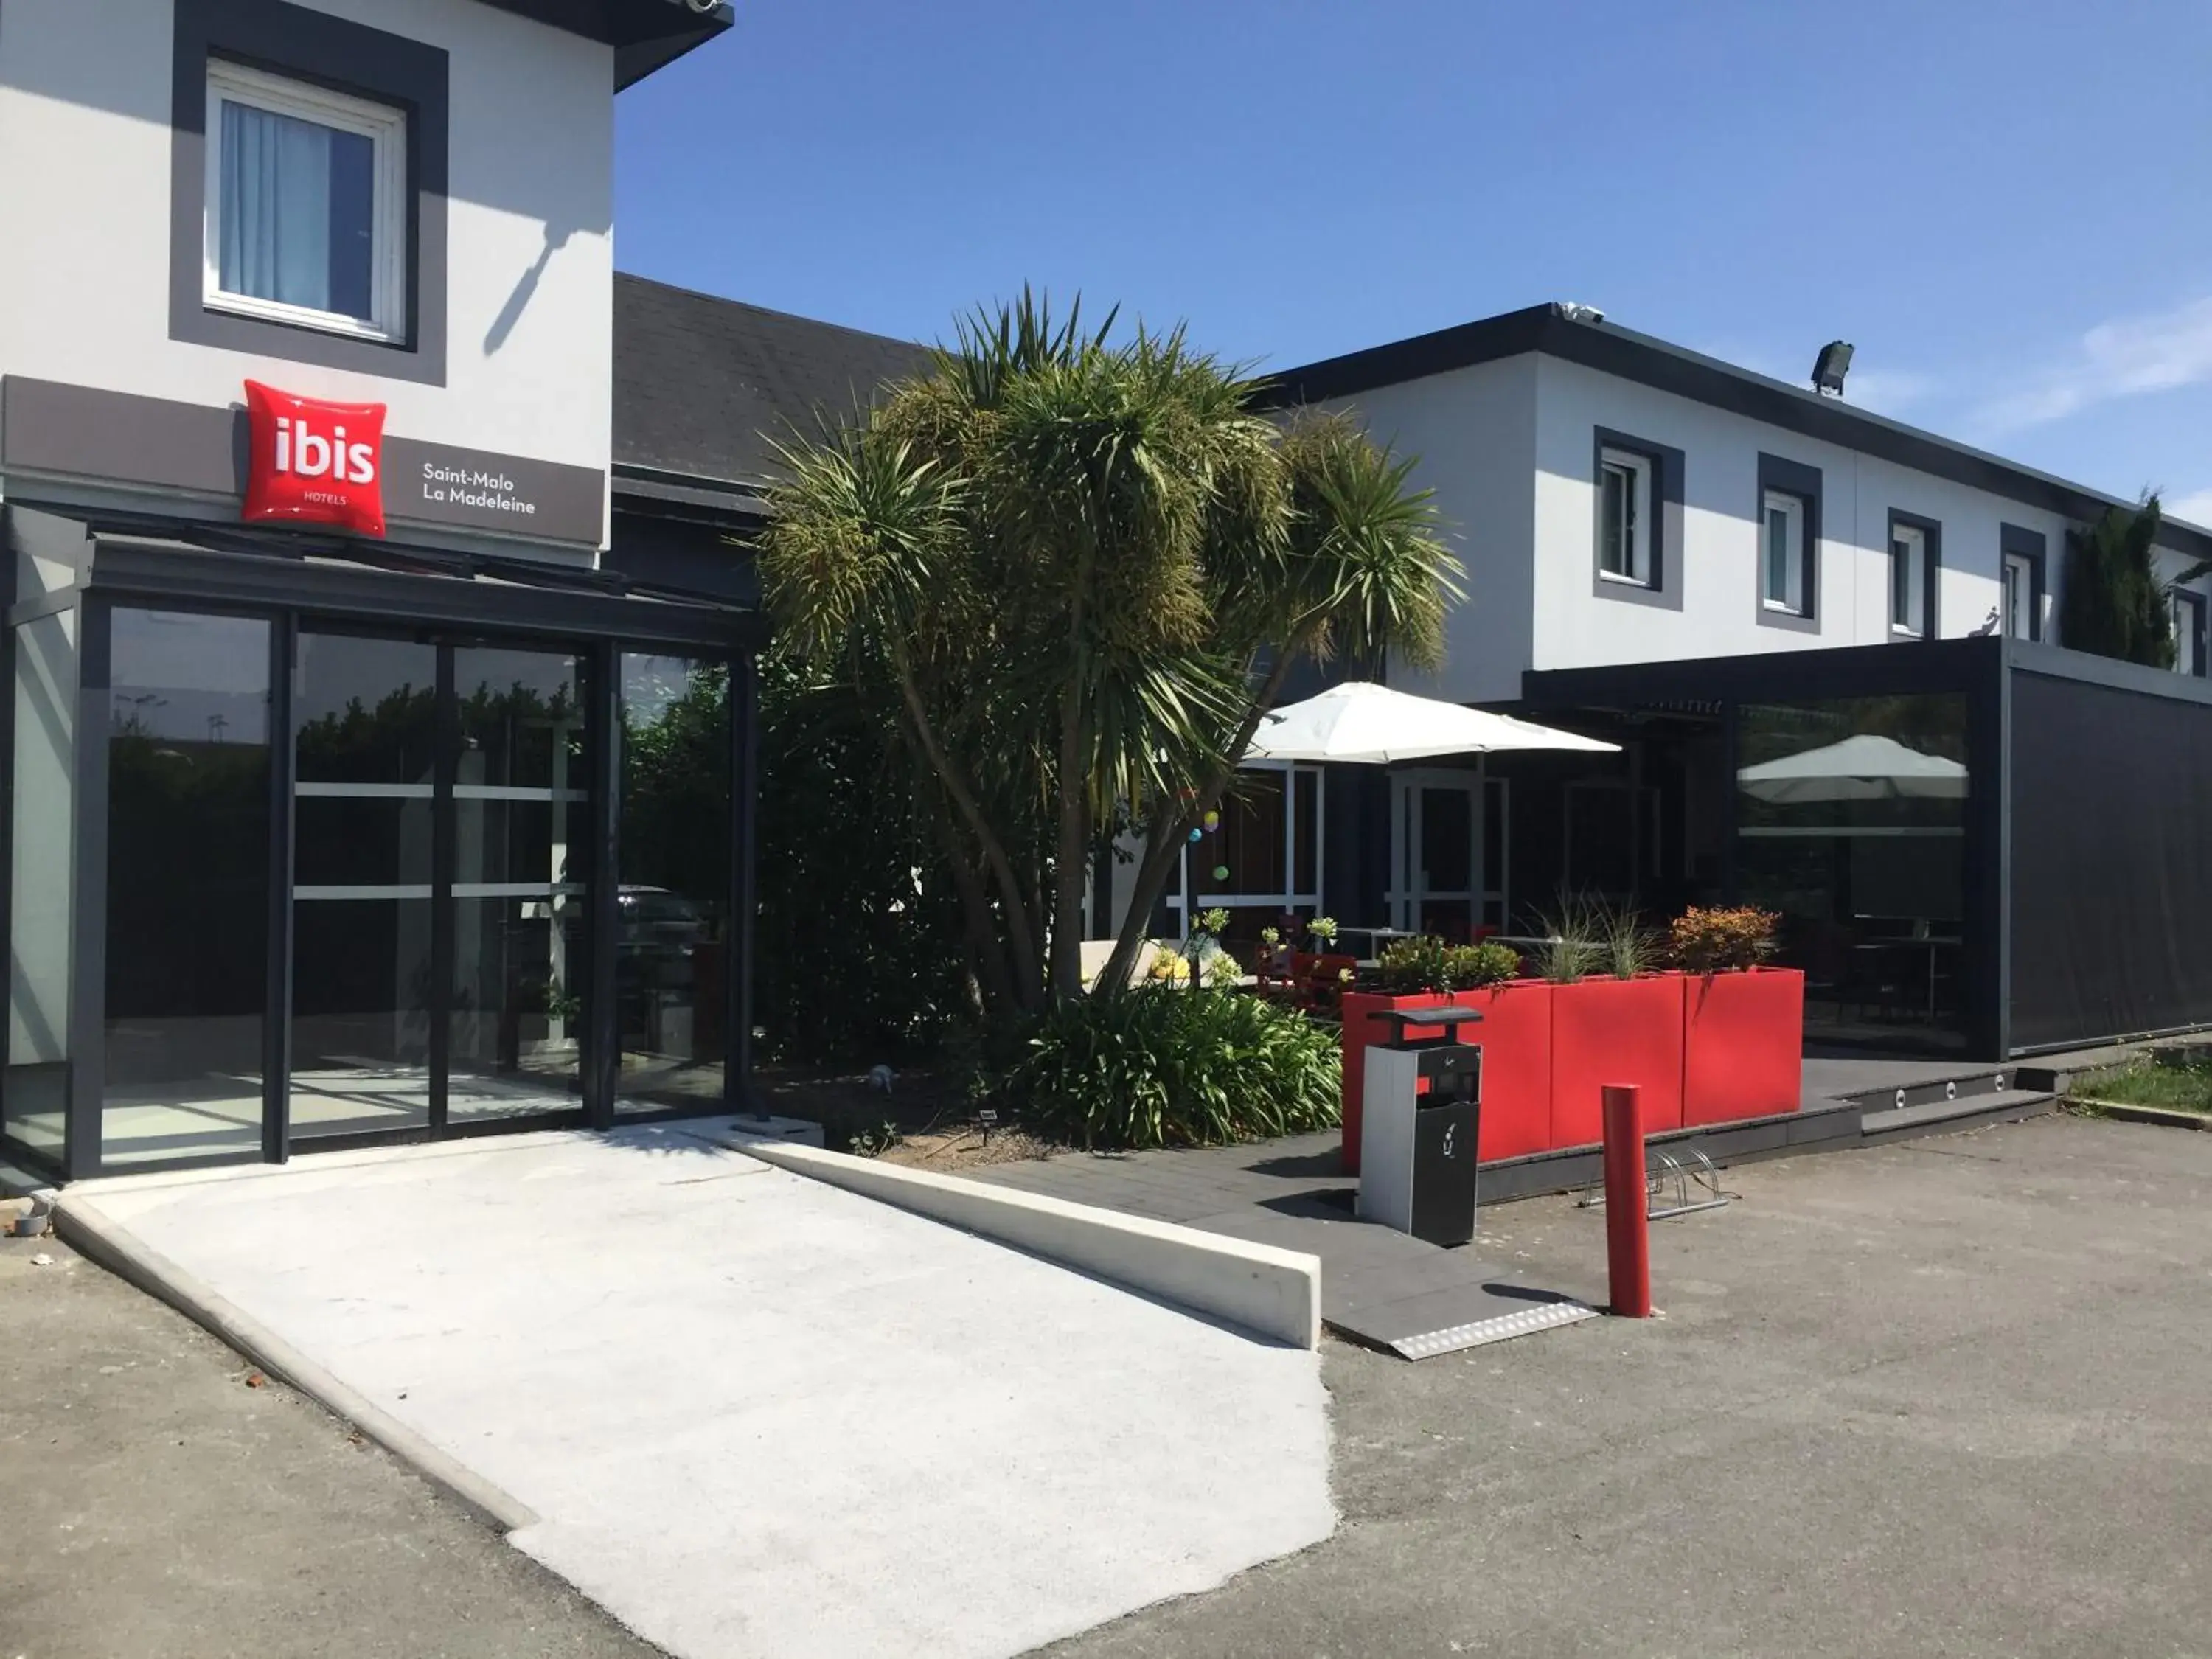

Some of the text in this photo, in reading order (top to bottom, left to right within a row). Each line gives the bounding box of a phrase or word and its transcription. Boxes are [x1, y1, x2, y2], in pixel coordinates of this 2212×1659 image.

[276, 416, 375, 484] ibis
[423, 462, 514, 491] Saint-Malo
[303, 490, 347, 506] HOTELS
[423, 484, 535, 515] La Madeleine
